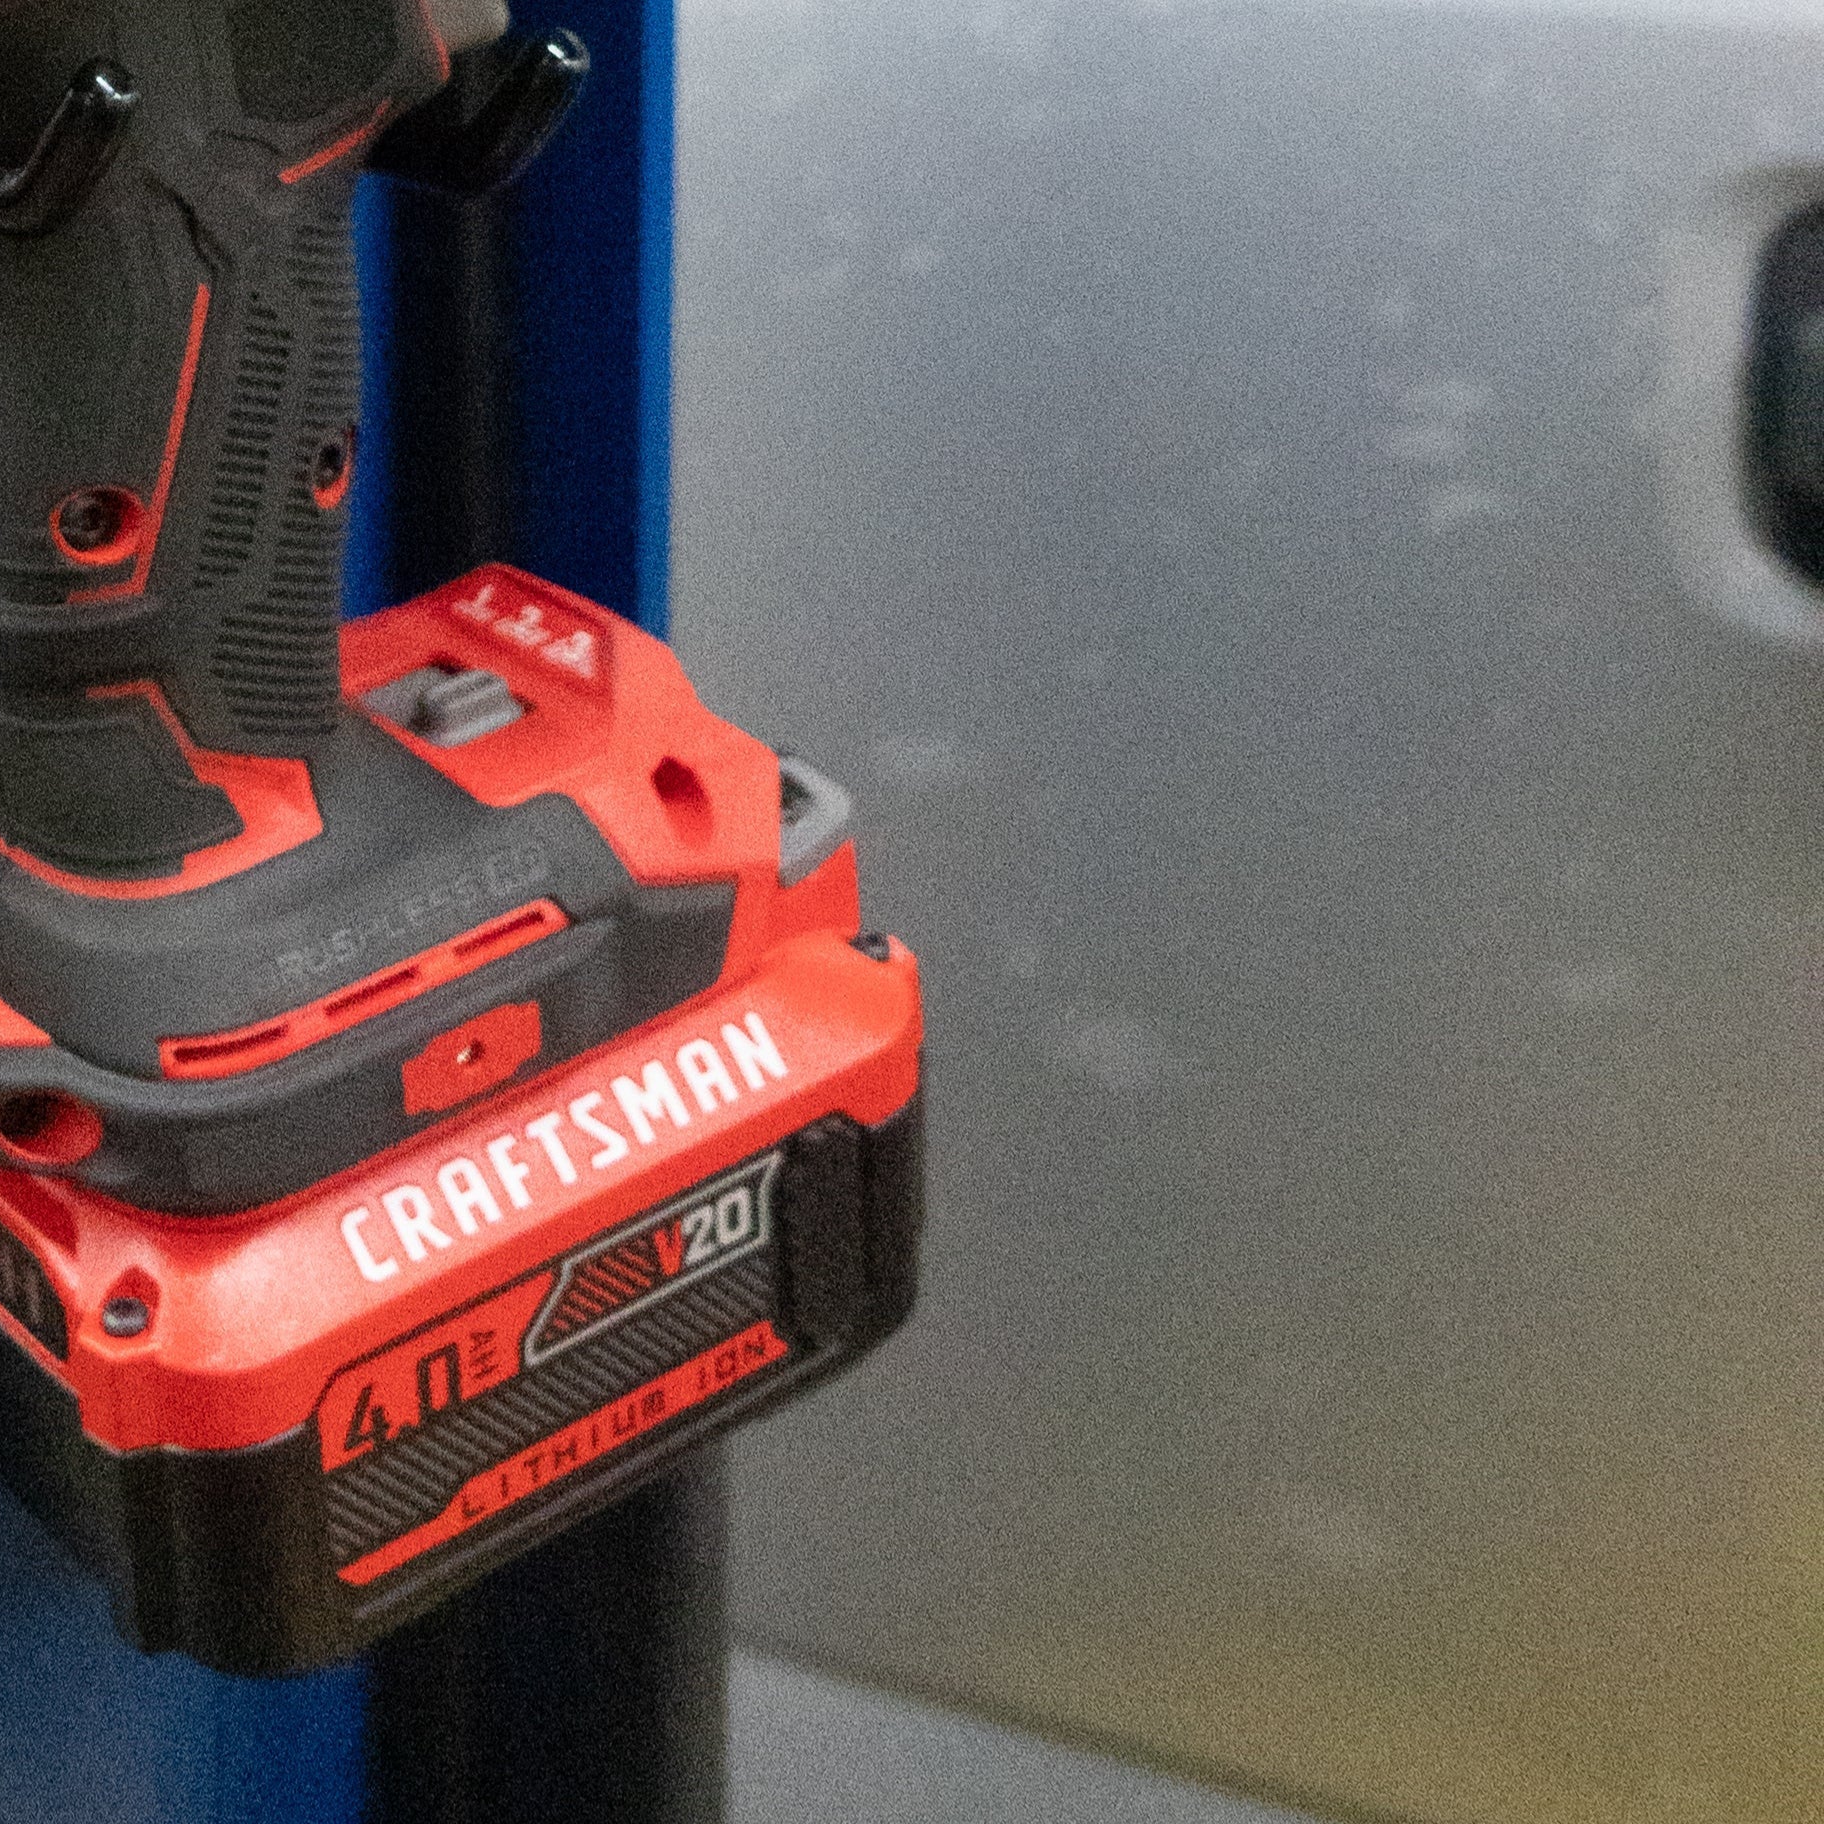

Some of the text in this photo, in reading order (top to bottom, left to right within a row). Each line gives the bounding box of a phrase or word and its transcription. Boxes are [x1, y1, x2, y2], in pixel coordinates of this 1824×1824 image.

[340, 1011, 789, 1282] CRAFTSMAN
[654, 1186, 750, 1275] V20
[344, 1341, 463, 1454] 4.0
[460, 1335, 767, 1519] LITHIUM ION
